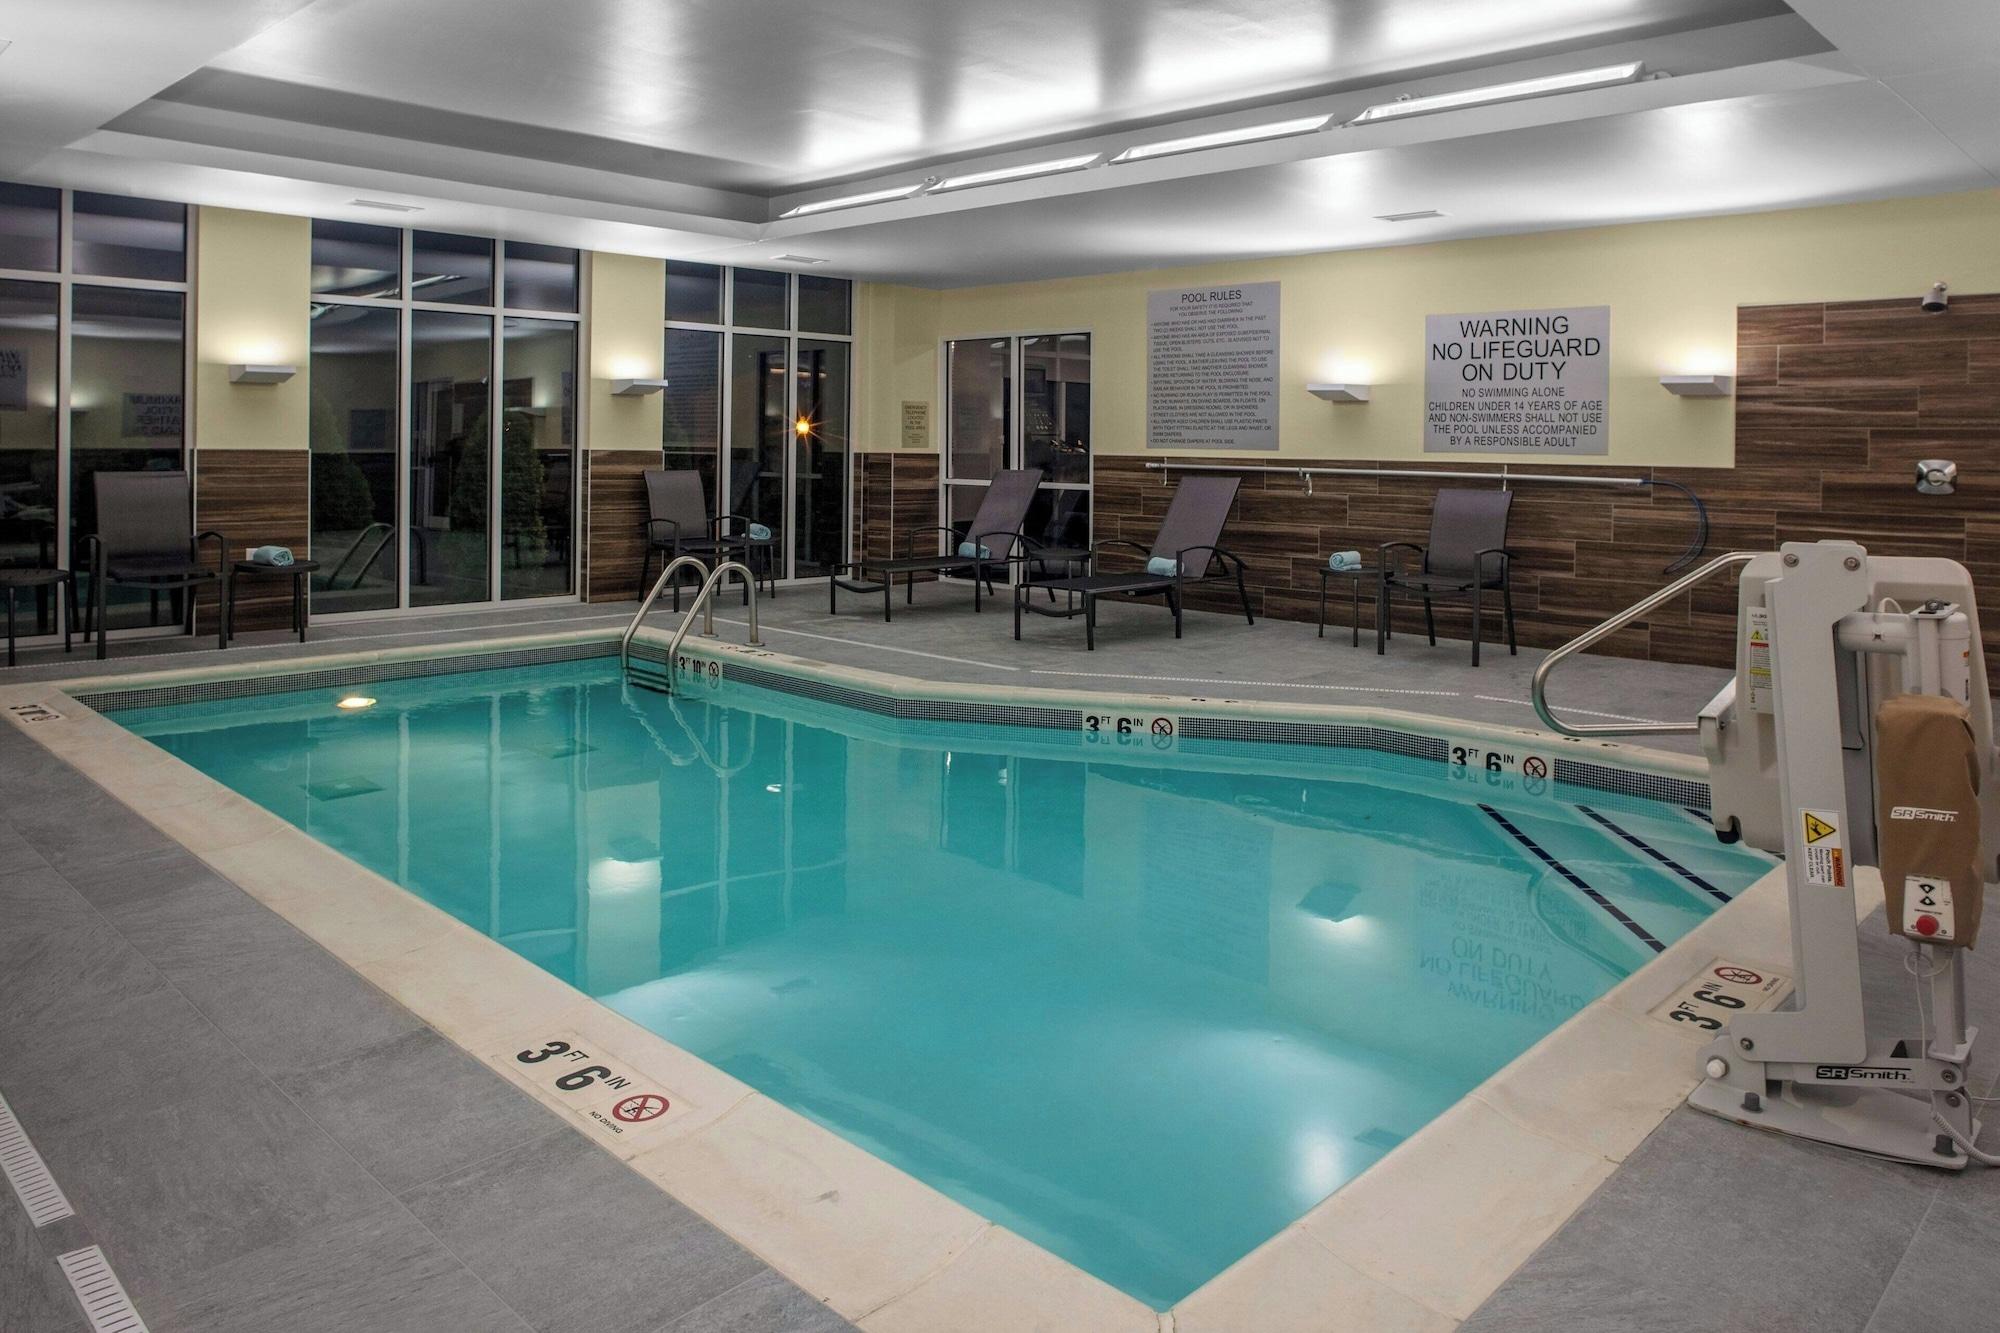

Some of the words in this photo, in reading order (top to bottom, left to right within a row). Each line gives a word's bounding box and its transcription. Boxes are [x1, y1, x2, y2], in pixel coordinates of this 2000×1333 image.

[1181, 294, 1207, 303] POOL
[1210, 290, 1242, 301] RULES
[1460, 316, 1568, 337] WARNING
[1432, 342, 1462, 360] NO
[1471, 338, 1600, 359] LIFEGUARD
[1462, 363, 1492, 381] ON
[1504, 362, 1566, 380] DUTY
[1462, 388, 1475, 398] NO
[1478, 387, 1528, 397] SWIMMING
[1532, 387, 1565, 396] ALONE
[1429, 402, 1474, 411] CHILDREN
[1478, 401, 1510, 411] UNDER
[1514, 401, 1524, 410] 14
[1528, 401, 1560, 410] YEARS
[1564, 401, 1577, 410] OF
[1581, 401, 1602, 411] AGE
[1429, 413, 1446, 423] AND
[1450, 413, 1521, 423] NON-SWIMMERS
[1525, 413, 1554, 423] SHALL
[1558, 413, 1579, 423] NOT
[1582, 413, 1602, 423] USE
[1434, 425, 1450, 434] THE
[1454, 425, 1478, 434] POOL
[1482, 425, 1519, 434] UNLESS
[1522, 425, 1596, 435] ACCOMPANIED
[1450, 436, 1462, 446] BY
[1464, 436, 1471, 446] A
[1474, 436, 1540, 446] RESPONSIBLE
[1544, 437, 1576, 447] ADULT
[1086, 716, 1099, 731] 3
[1117, 718, 1132, 734] 6
[1452, 747, 1466, 766] 3
[1486, 752, 1501, 771] 6
[1693, 990, 1746, 1009] 6
[1669, 1010, 1722, 1030] 3
[516, 1042, 570, 1063] 3
[563, 1050, 590, 1062] FT
[556, 1066, 611, 1090] 6
[604, 1076, 631, 1090] IN
[589, 1111, 602, 1120] NO
[600, 1115, 624, 1134] DIVING
